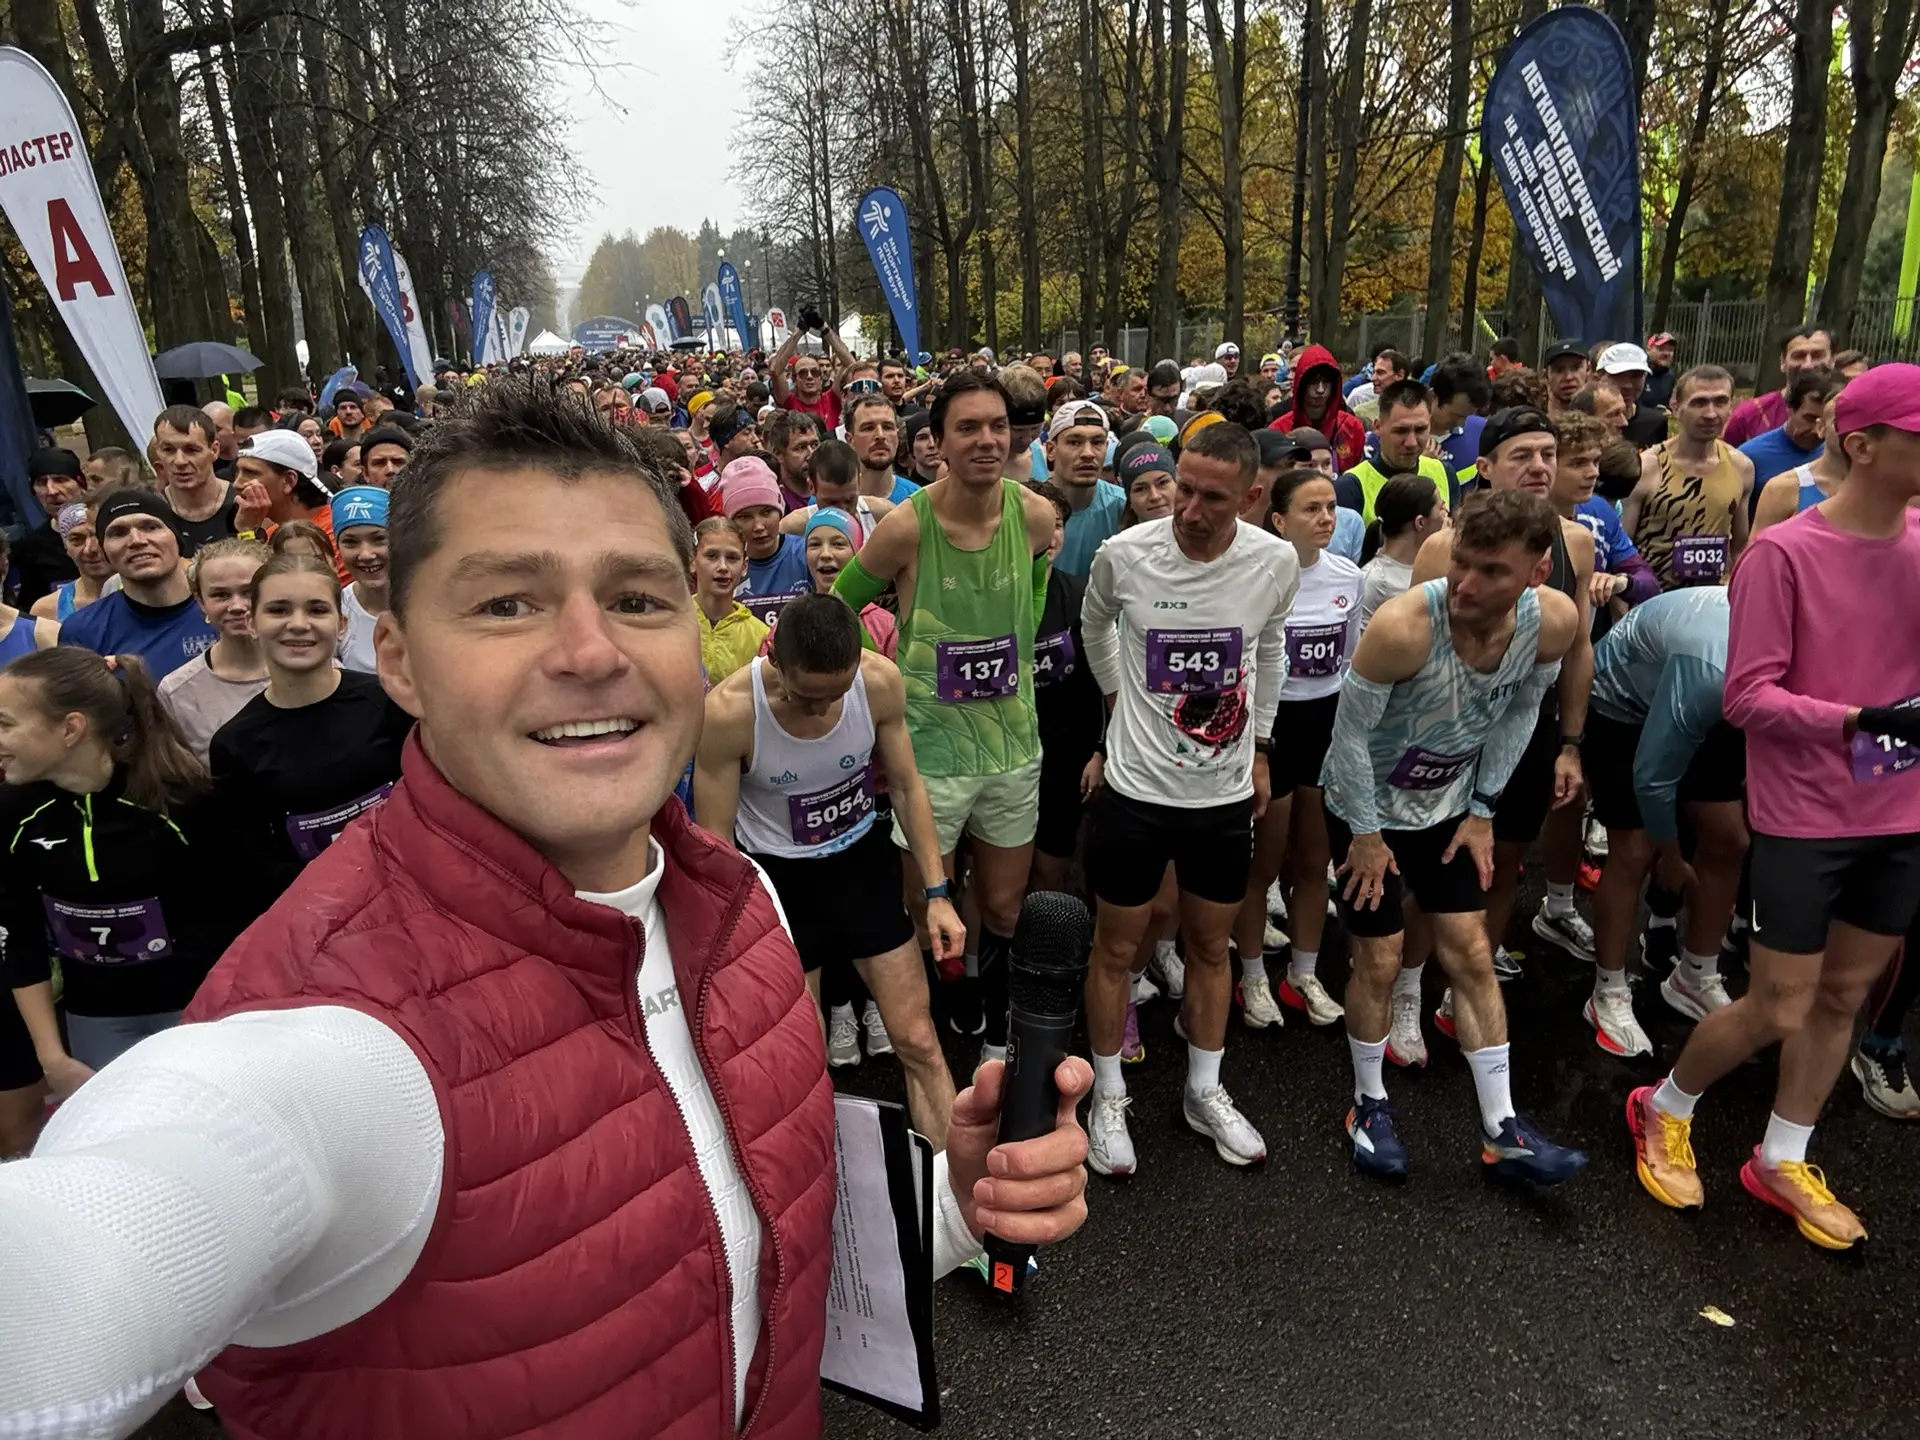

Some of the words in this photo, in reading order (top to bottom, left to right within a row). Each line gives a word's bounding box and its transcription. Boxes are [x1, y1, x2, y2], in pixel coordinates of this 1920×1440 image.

[1521, 59, 1623, 283] ЛЕГКОАТЛЕТИЧЕСКИЙ
[1533, 139, 1575, 221] ПРОБЕГ
[1500, 141, 1558, 273] САНКТ-ПЕТЕРБУРГА
[1504, 113, 1518, 138] НА
[1513, 136, 1539, 184] КУБОК
[1533, 182, 1577, 281] ГУБЕРНАТОРА
[47, 198, 116, 301] А
[876, 246, 901, 299] ПЕТЕРБУРГ
[882, 241, 913, 311] СПОРТИВНЫЙ
[1683, 549, 1724, 564] 5032
[959, 658, 1005, 681] 137
[1168, 651, 1220, 672] 543
[1299, 640, 1335, 660] 501
[806, 787, 866, 828] 5054
[90, 927, 111, 945] 7
[644, 984, 679, 1019] AR
[997, 1267, 1008, 1286] 2
